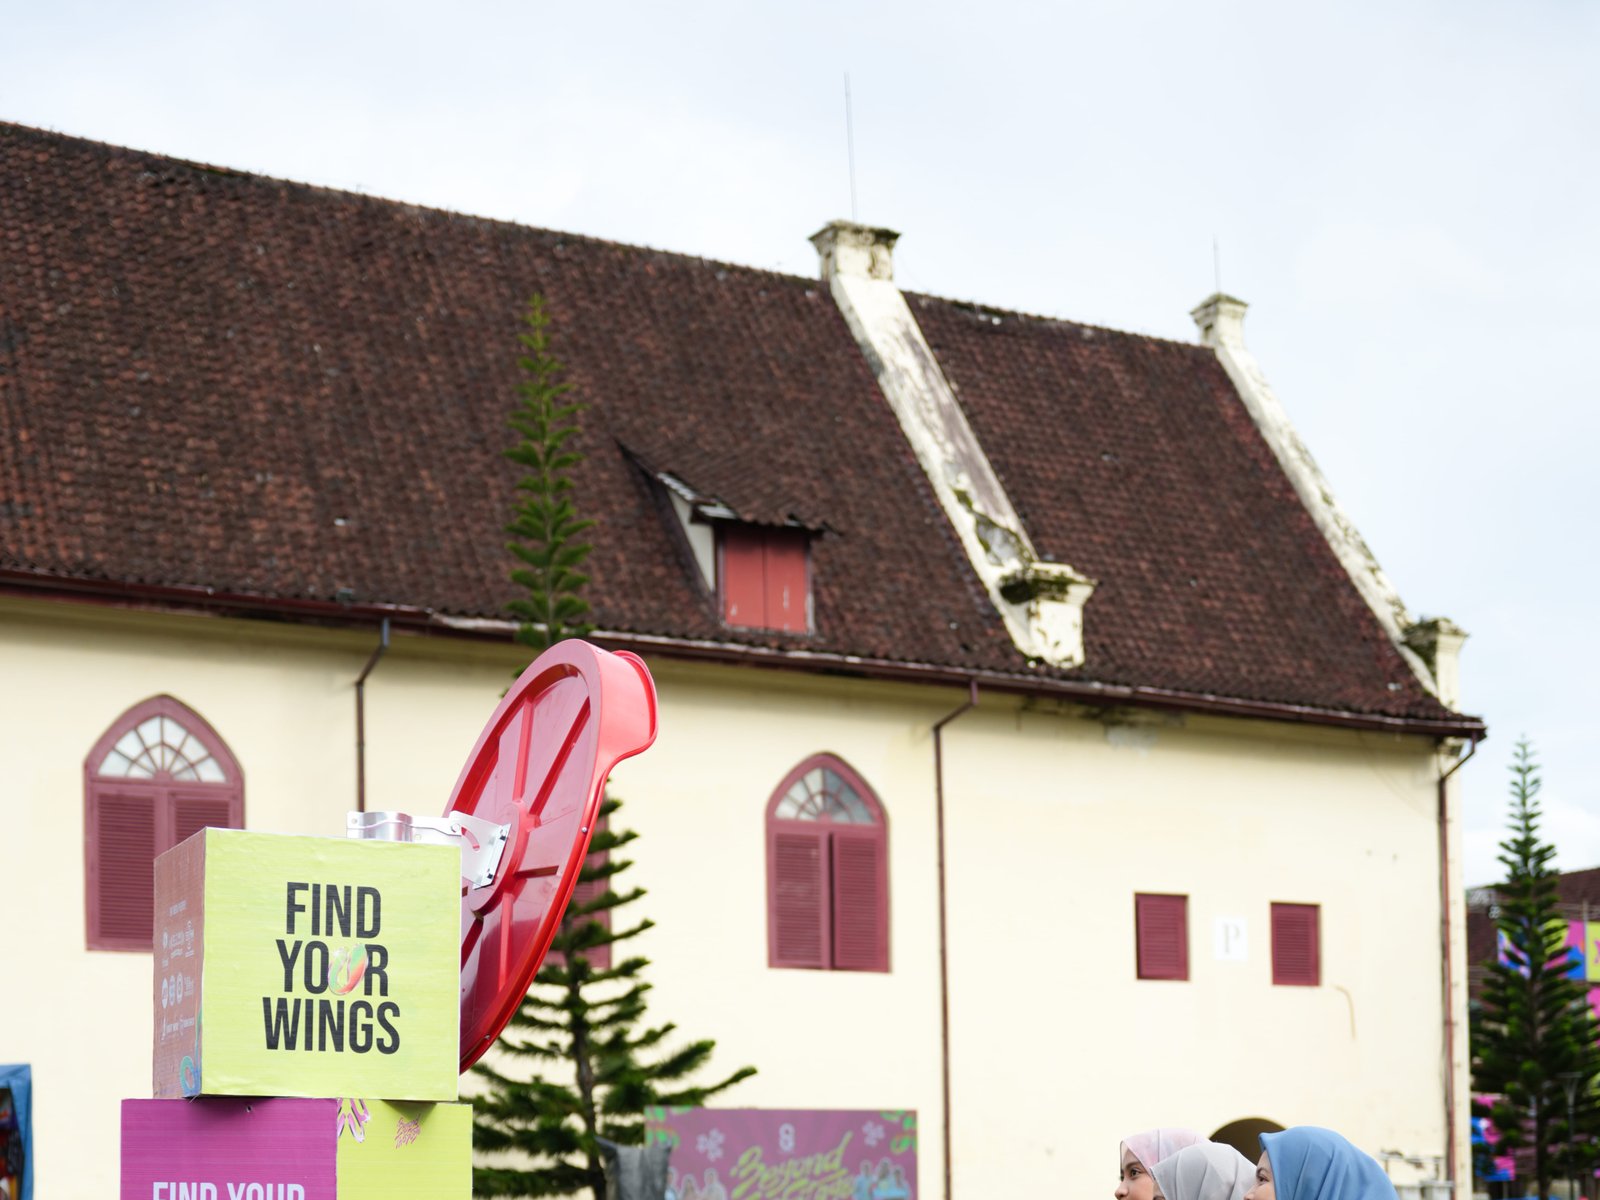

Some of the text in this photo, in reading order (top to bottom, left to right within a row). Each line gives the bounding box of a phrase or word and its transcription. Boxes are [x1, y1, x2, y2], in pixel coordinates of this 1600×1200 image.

[286, 882, 381, 939] FIND
[1222, 922, 1241, 955] P
[276, 939, 389, 997] YOUR
[262, 997, 401, 1055] WINGS
